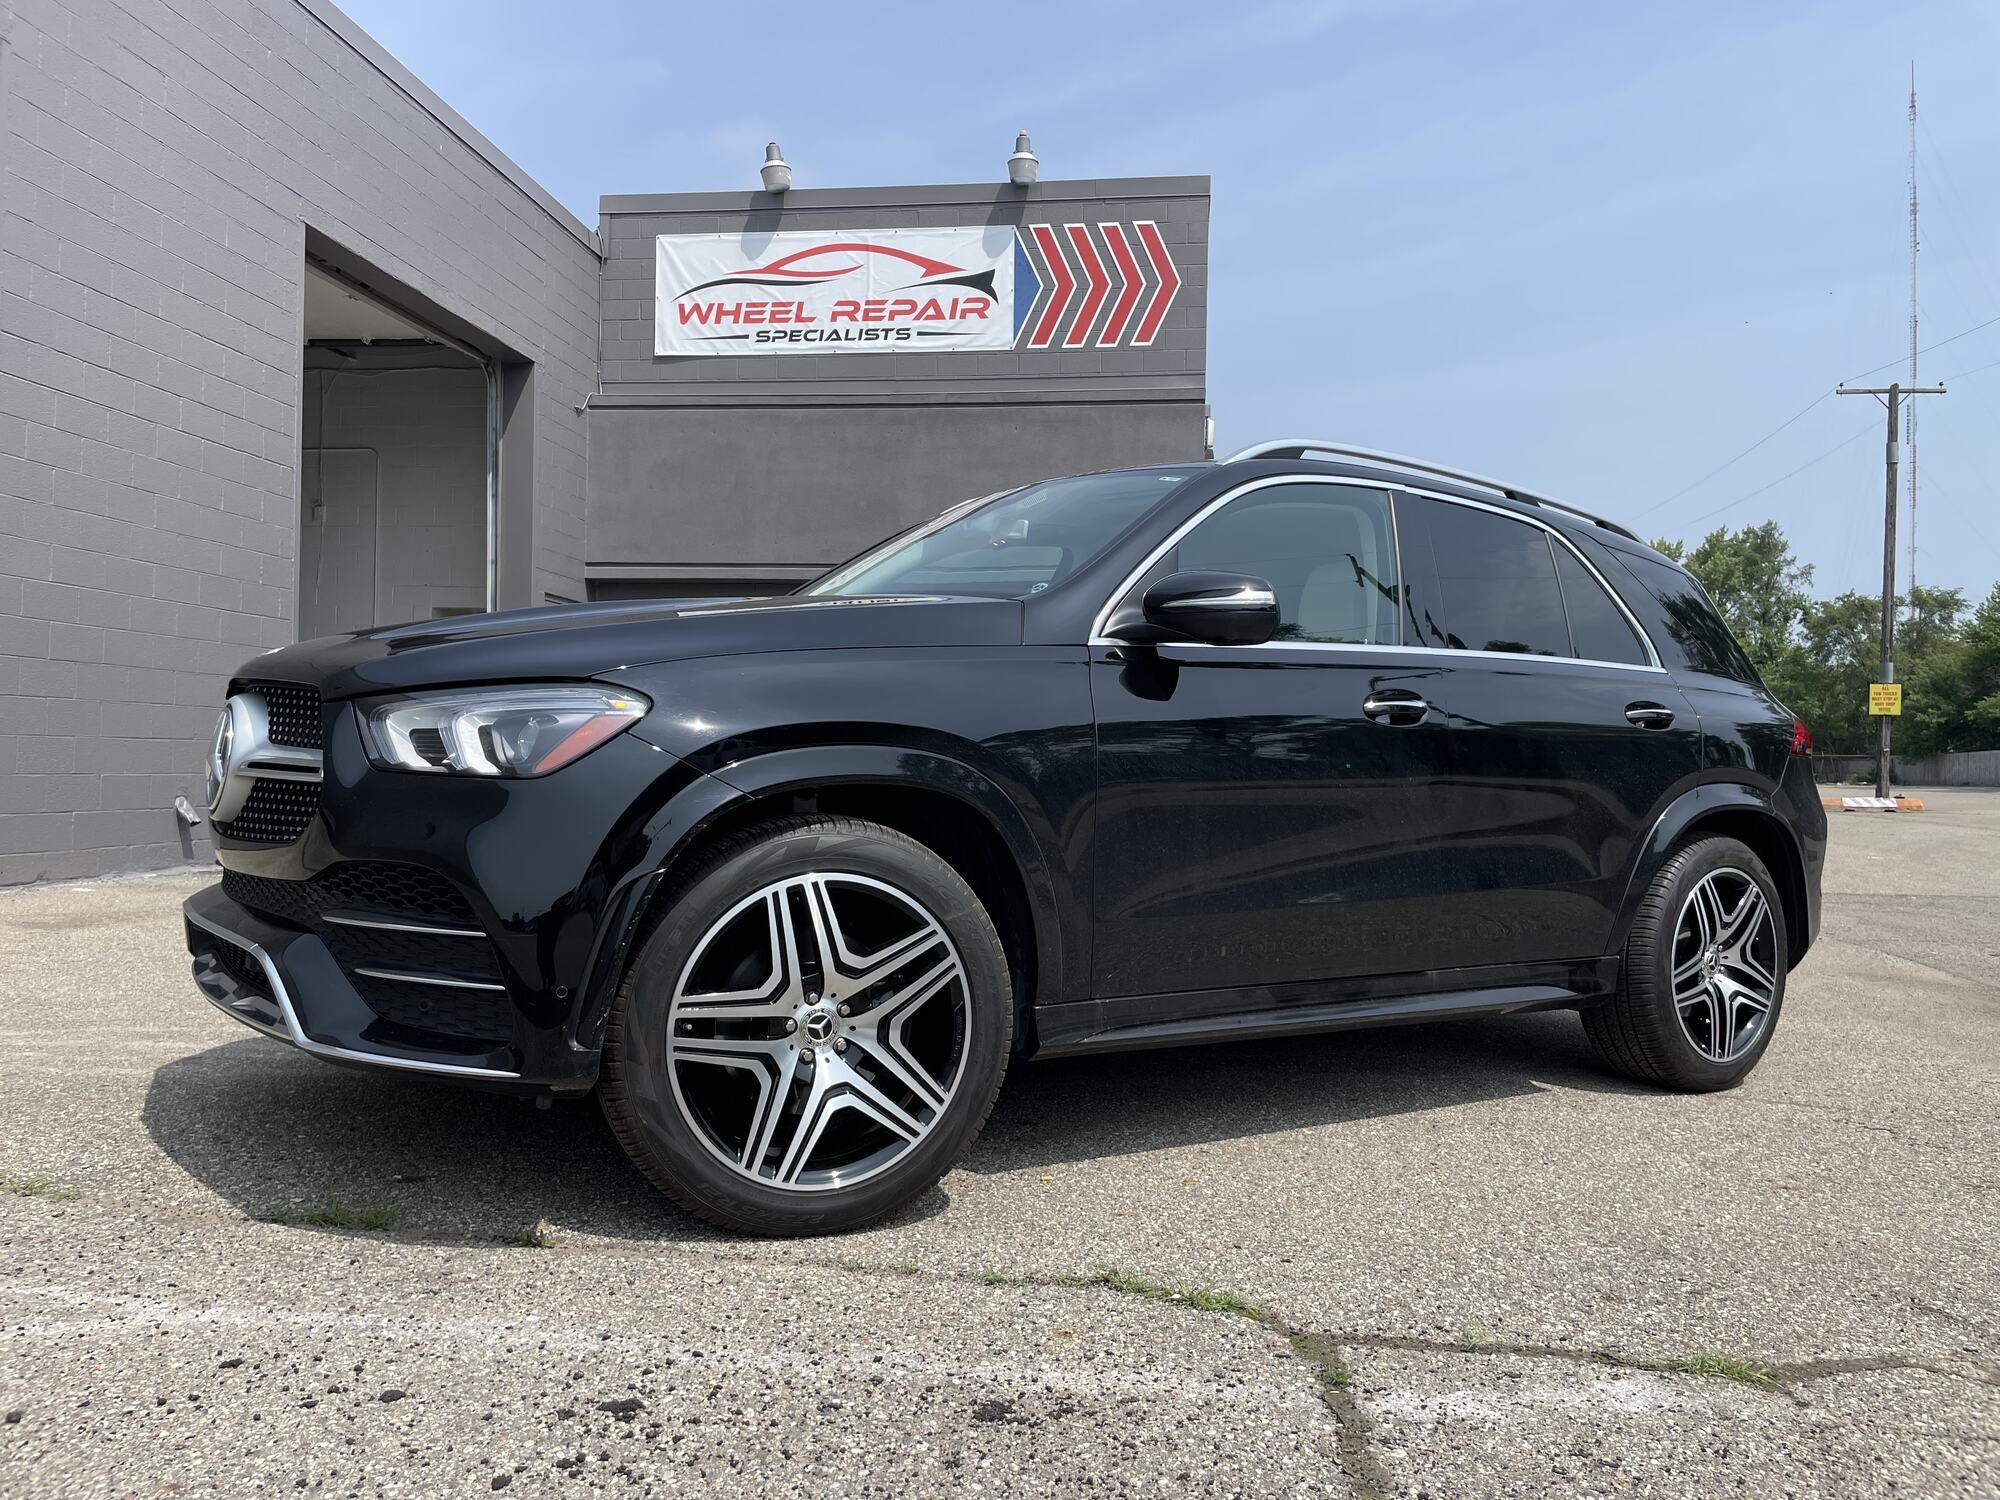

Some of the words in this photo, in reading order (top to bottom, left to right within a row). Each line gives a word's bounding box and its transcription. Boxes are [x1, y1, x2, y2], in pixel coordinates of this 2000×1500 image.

[678, 301, 817, 325] WHEEL
[830, 296, 991, 322] REPAIR
[755, 327, 912, 342] SPECIALISTS
